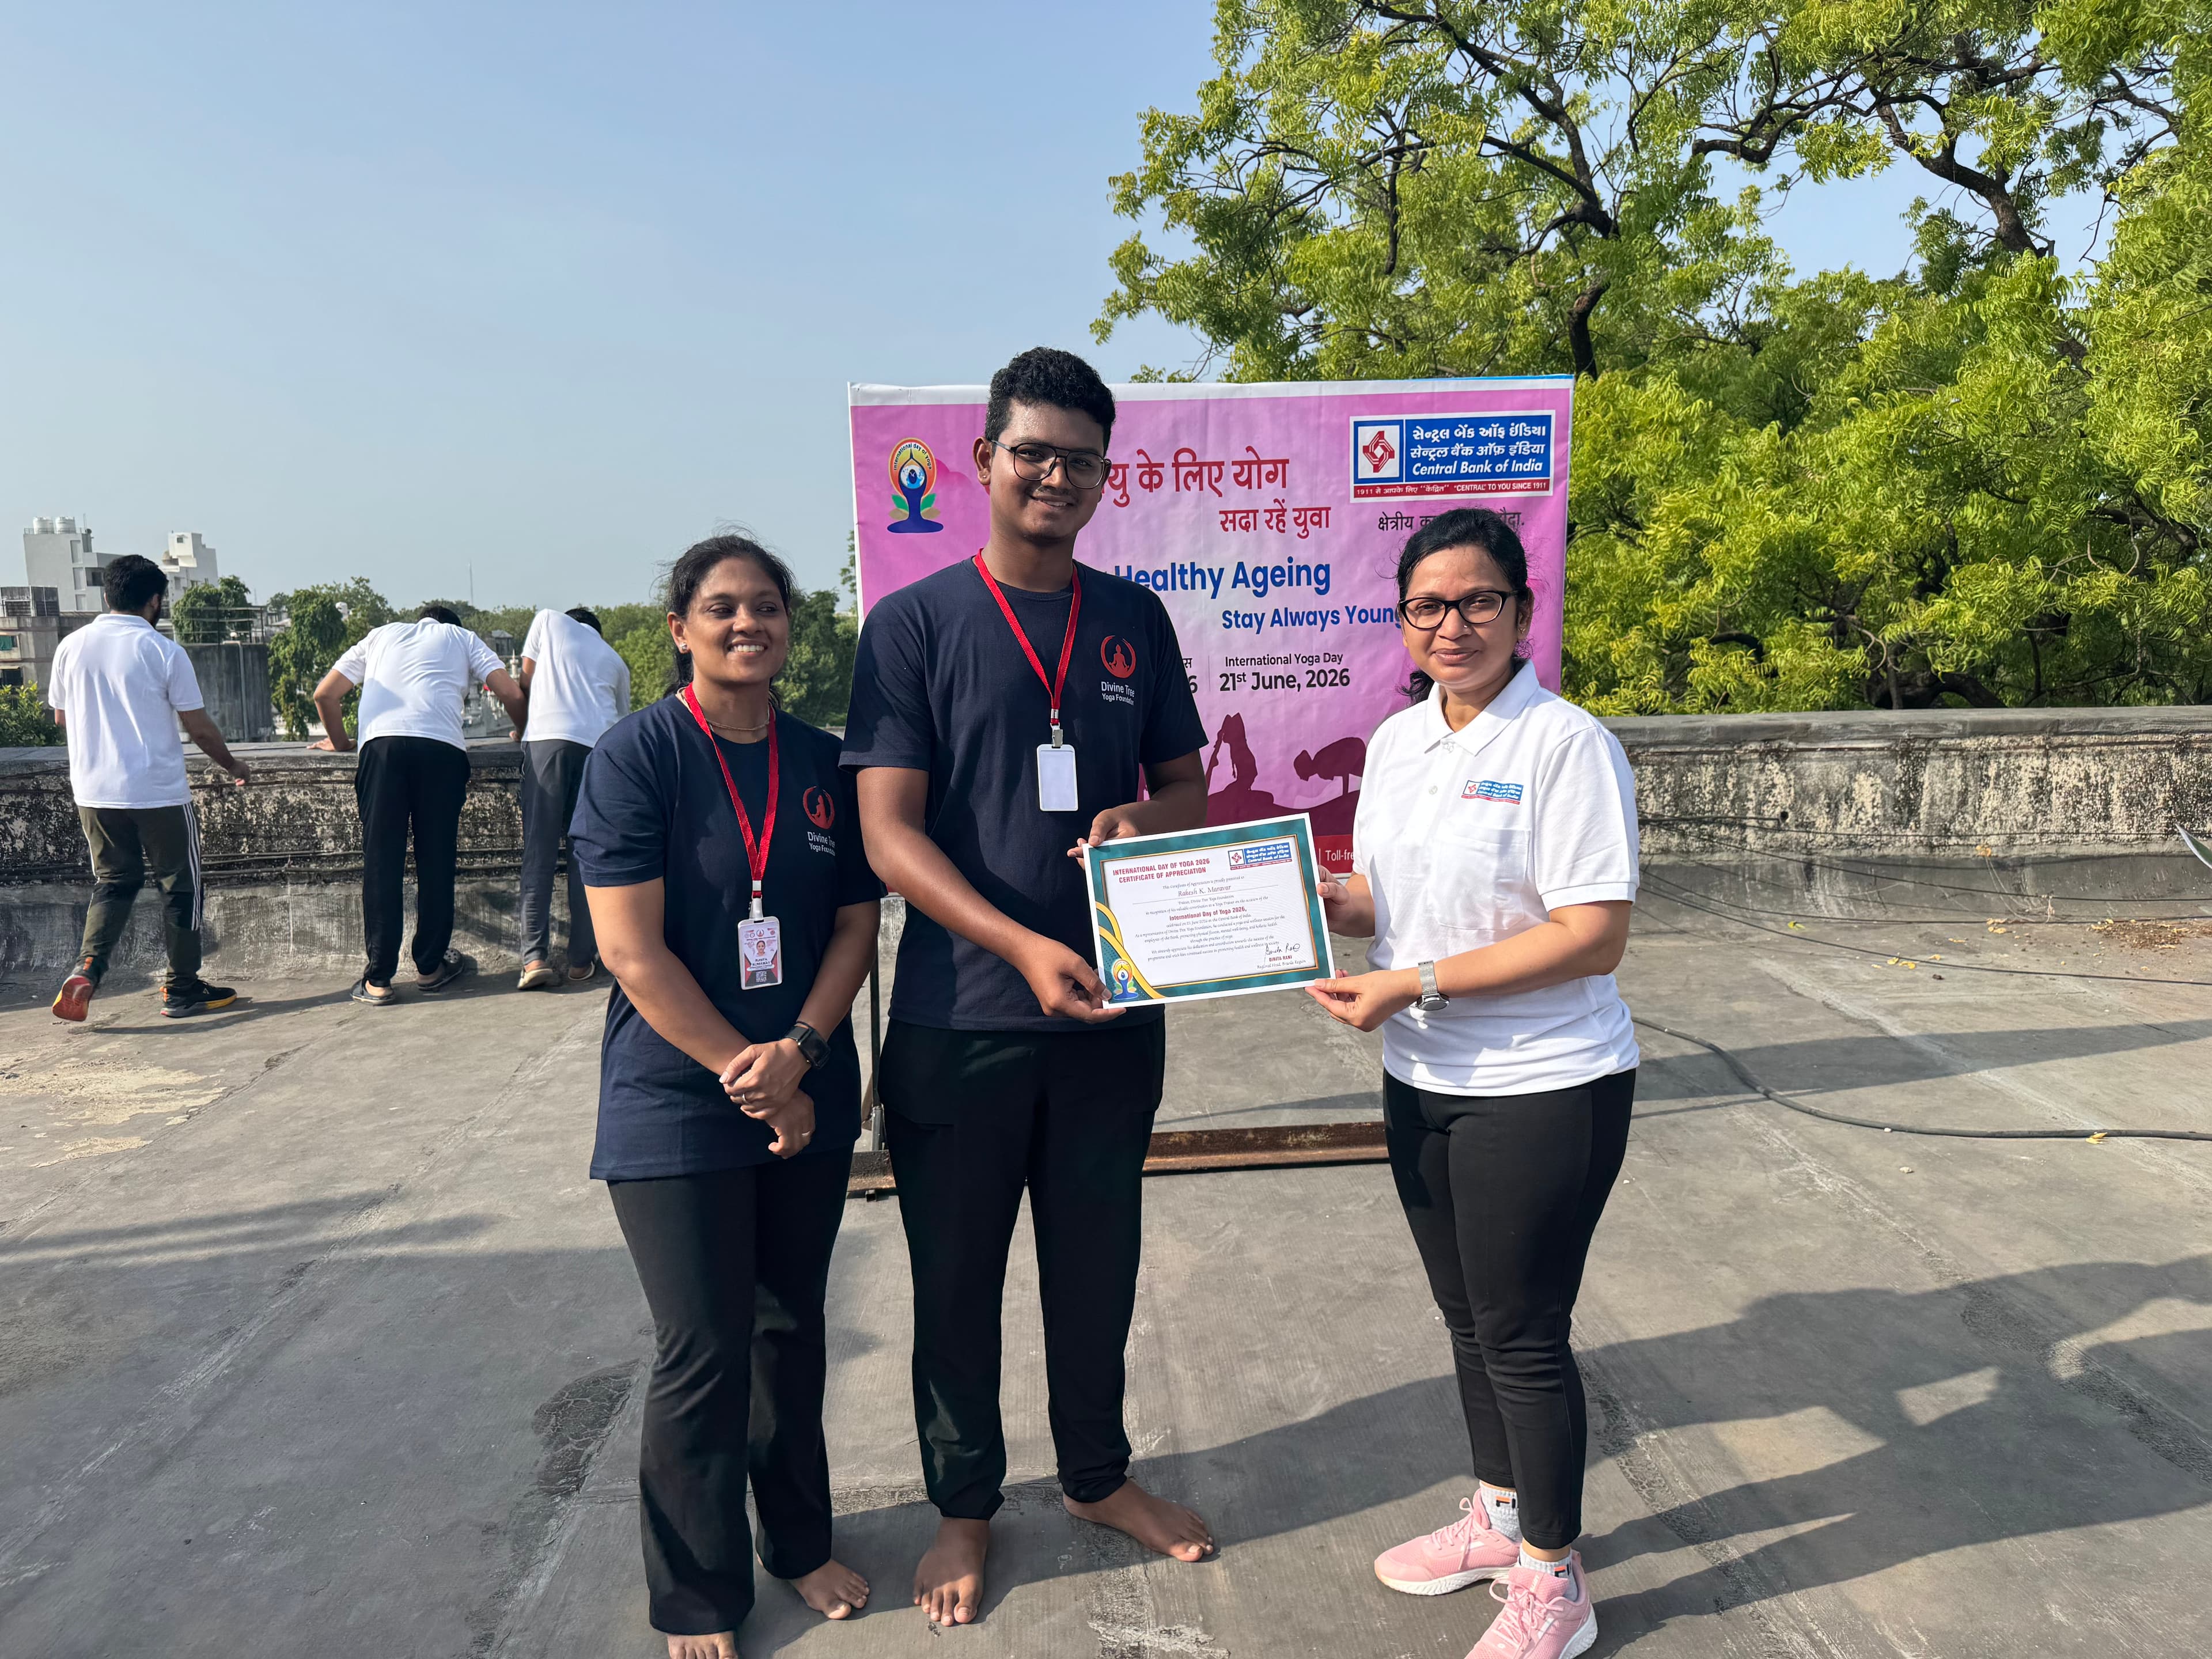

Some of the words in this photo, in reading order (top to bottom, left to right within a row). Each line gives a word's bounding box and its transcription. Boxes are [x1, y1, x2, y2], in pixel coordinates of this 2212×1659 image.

[894, 443, 912, 470] International
[1410, 445, 1449, 461] सेन्ट्रल
[1450, 443, 1474, 457] बैंक
[1509, 441, 1546, 456] इंडिया
[1412, 461, 1457, 476] Central
[1460, 460, 1492, 474] Bank
[1495, 459, 1509, 472] of
[1511, 459, 1543, 472] India
[1102, 463, 1130, 507] यु
[1137, 449, 1165, 493] के
[1172, 448, 1225, 497] लिए
[1232, 446, 1290, 490] योग
[1406, 485, 1418, 493] लिए
[1219, 509, 1259, 532] सदा
[1264, 498, 1287, 533] रहें
[1293, 506, 1332, 539] युवा
[1378, 511, 1414, 531] क्षेत्रीय
[1115, 562, 1225, 600] Healthy
[1231, 556, 1331, 598] Ageing
[1222, 609, 1266, 634] Stay
[1270, 607, 1340, 632] Always
[1225, 653, 1291, 667] International
[1294, 653, 1320, 666] Yoga
[1323, 653, 1343, 665] Day
[1219, 672, 1247, 692] 21st
[1251, 672, 1301, 692] June,
[1305, 668, 1350, 688] 2026
[1101, 681, 1124, 694] Divine
[1125, 684, 1135, 698] Tree
[1101, 693, 1115, 702] Yoga
[807, 831, 828, 844] Divine
[809, 842, 821, 852] Yoga
[1112, 865, 1156, 876] INTERNATIONAL
[1119, 873, 1154, 883] CERTIFICATE
[1165, 866, 1206, 877] APPRECIATION
[1177, 888, 1197, 896] Rakesh
[1207, 884, 1231, 892] Maravar
[1169, 912, 1201, 921] International
